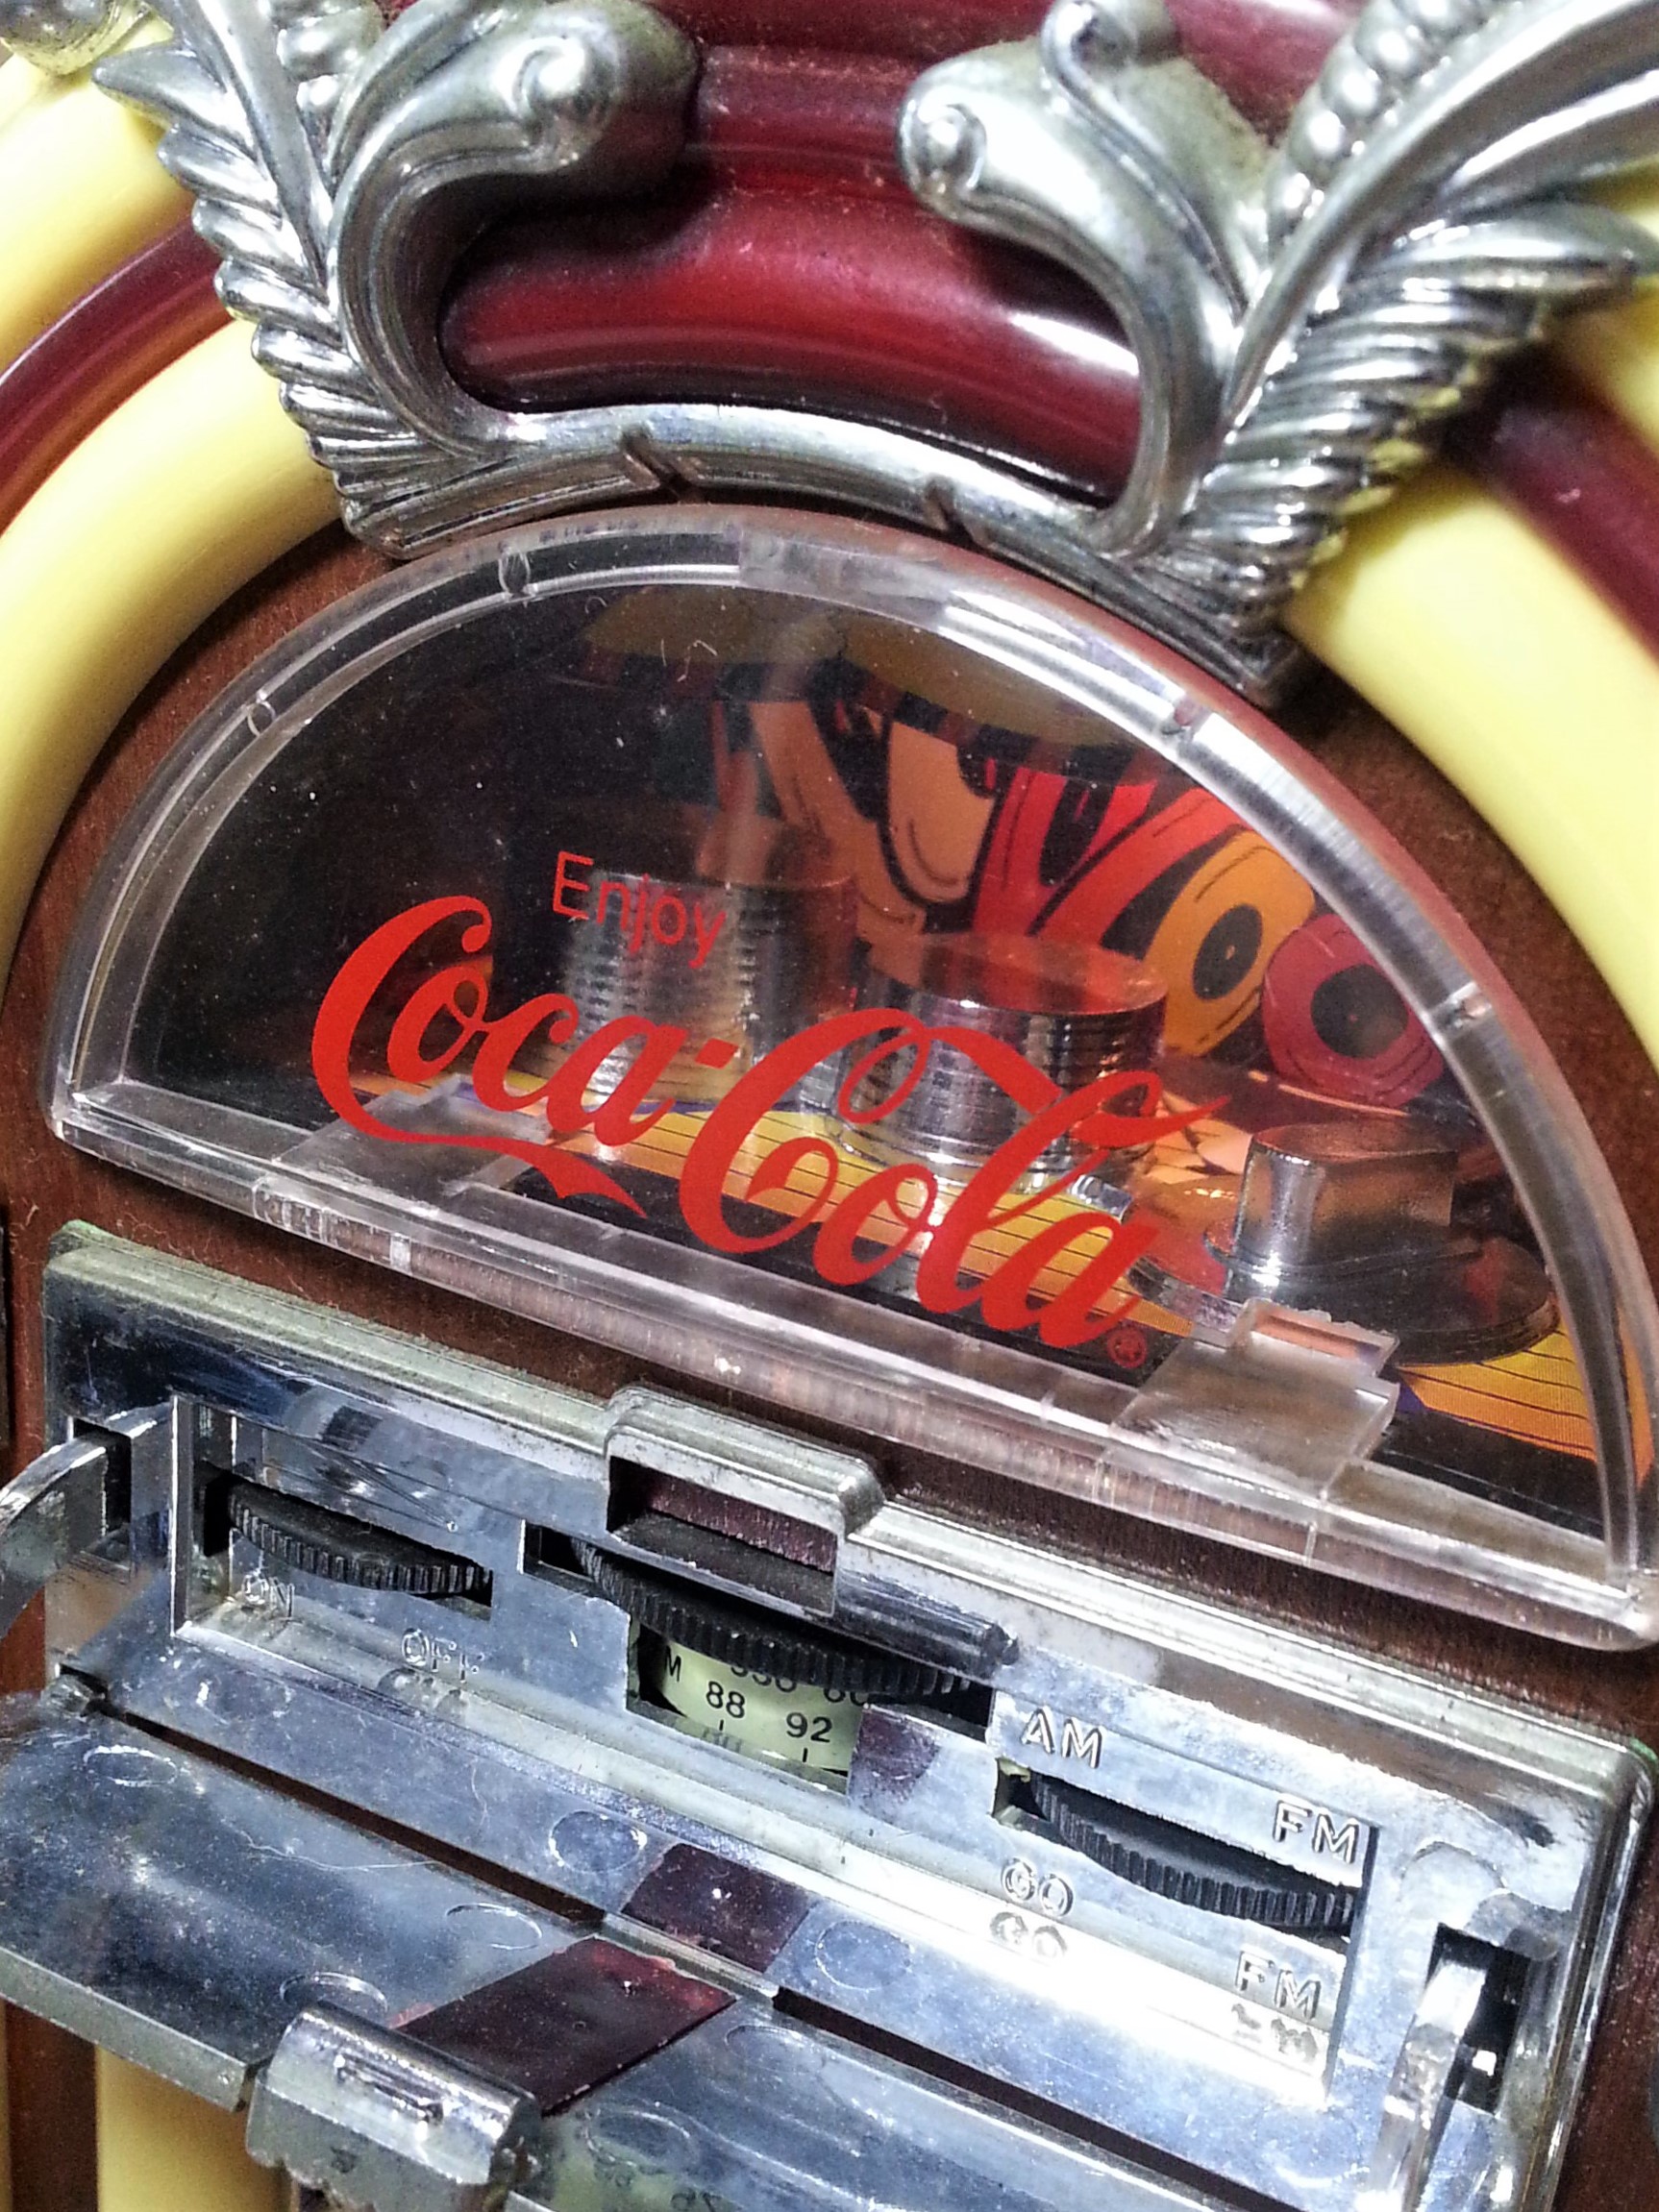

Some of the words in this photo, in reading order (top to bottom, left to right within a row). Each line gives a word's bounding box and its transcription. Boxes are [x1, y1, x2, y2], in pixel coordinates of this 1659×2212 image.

[552, 850, 728, 969] Enjoy
[311, 895, 1231, 1348] Coca-Cola
[706, 1681, 746, 1719] 88
[786, 1711, 833, 1744] 92
[1021, 1706, 1104, 1769] AM
[1272, 1798, 1361, 1865] FM
[1235, 1950, 1322, 2020] FM
